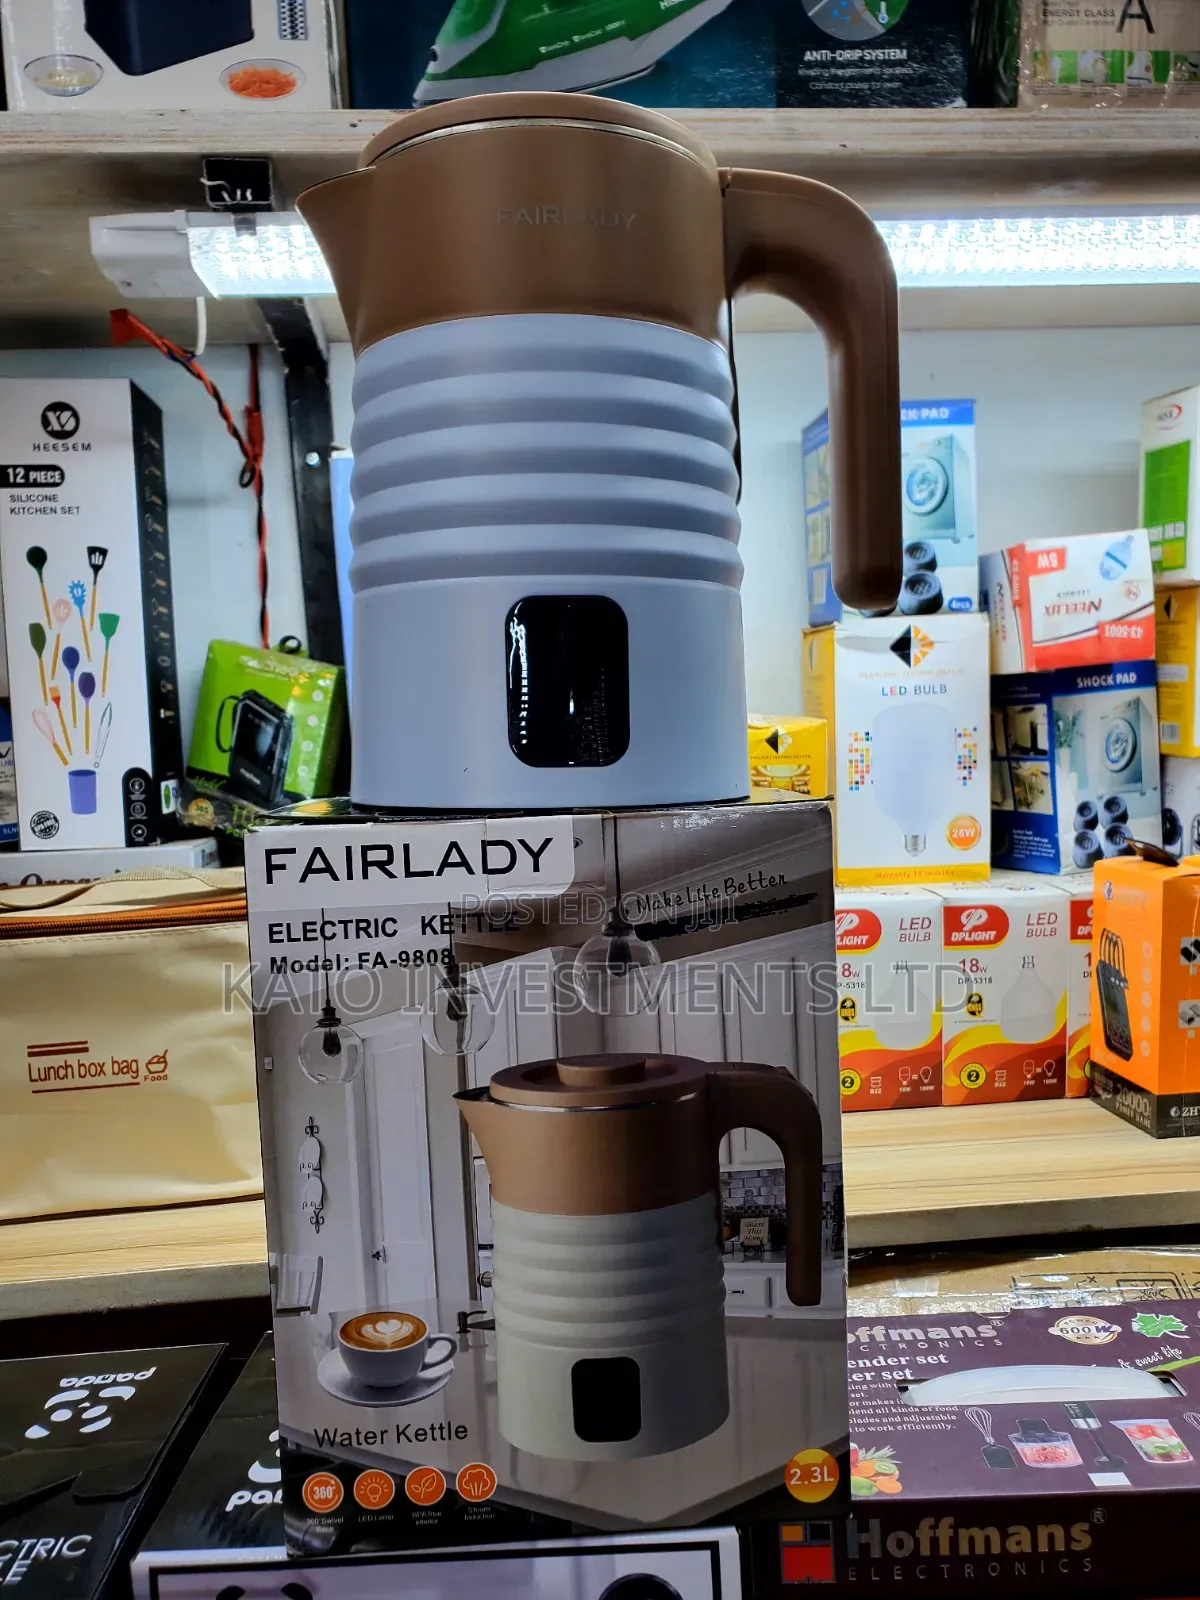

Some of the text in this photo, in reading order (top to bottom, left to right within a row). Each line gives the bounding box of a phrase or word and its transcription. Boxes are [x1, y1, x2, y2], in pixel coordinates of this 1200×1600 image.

[1084, 8, 1116, 18] CLASS
[803, 49, 908, 61] ANTI-DRIP SYSTEM
[921, 407, 950, 420] PAD
[33, 442, 92, 451] HEESEM
[7, 467, 62, 484] 12 PIECE
[9, 494, 59, 503] SILICONE
[10, 506, 80, 515] KITCHEN SET
[1077, 672, 1137, 689] SHOCK PAD
[881, 684, 947, 697] LED BULB
[952, 827, 975, 838] 28W
[264, 837, 554, 885] FAIRLADY
[874, 871, 911, 880] Warranty
[636, 870, 789, 914] Make Life Better
[899, 917, 932, 931] LED
[1026, 912, 1058, 926] LED
[267, 911, 521, 944] ELECTRIC KETTLE
[1026, 927, 1058, 938] BULB
[899, 931, 932, 943] BULB
[951, 930, 997, 942] DPLIGHT
[270, 947, 452, 976] Model: FA-9808
[957, 976, 993, 985] DP-5318
[28, 1056, 140, 1083] Lunch box bag
[144, 1074, 168, 1082] Food
[970, 1071, 976, 1081] 2
[845, 1078, 852, 1088] 2
[916, 1353, 949, 1365] set
[1135, 1351, 1164, 1367] sweet
[1160, 1344, 1183, 1360] life
[58, 1366, 157, 1388] panda
[882, 1367, 915, 1380] set
[862, 1398, 895, 1406] makes
[891, 1405, 920, 1413] kinds
[882, 1415, 902, 1423] and
[903, 1413, 957, 1422] adjustable
[867, 1423, 895, 1432] work
[897, 1422, 957, 1431] efficiently.
[313, 1420, 468, 1448] Water Kettle
[790, 1466, 835, 1485] 2.3L
[358, 1515, 374, 1524] LED
[845, 1516, 1094, 1559] Hoffmans
[847, 1557, 1093, 1581] ELECTRONICS
